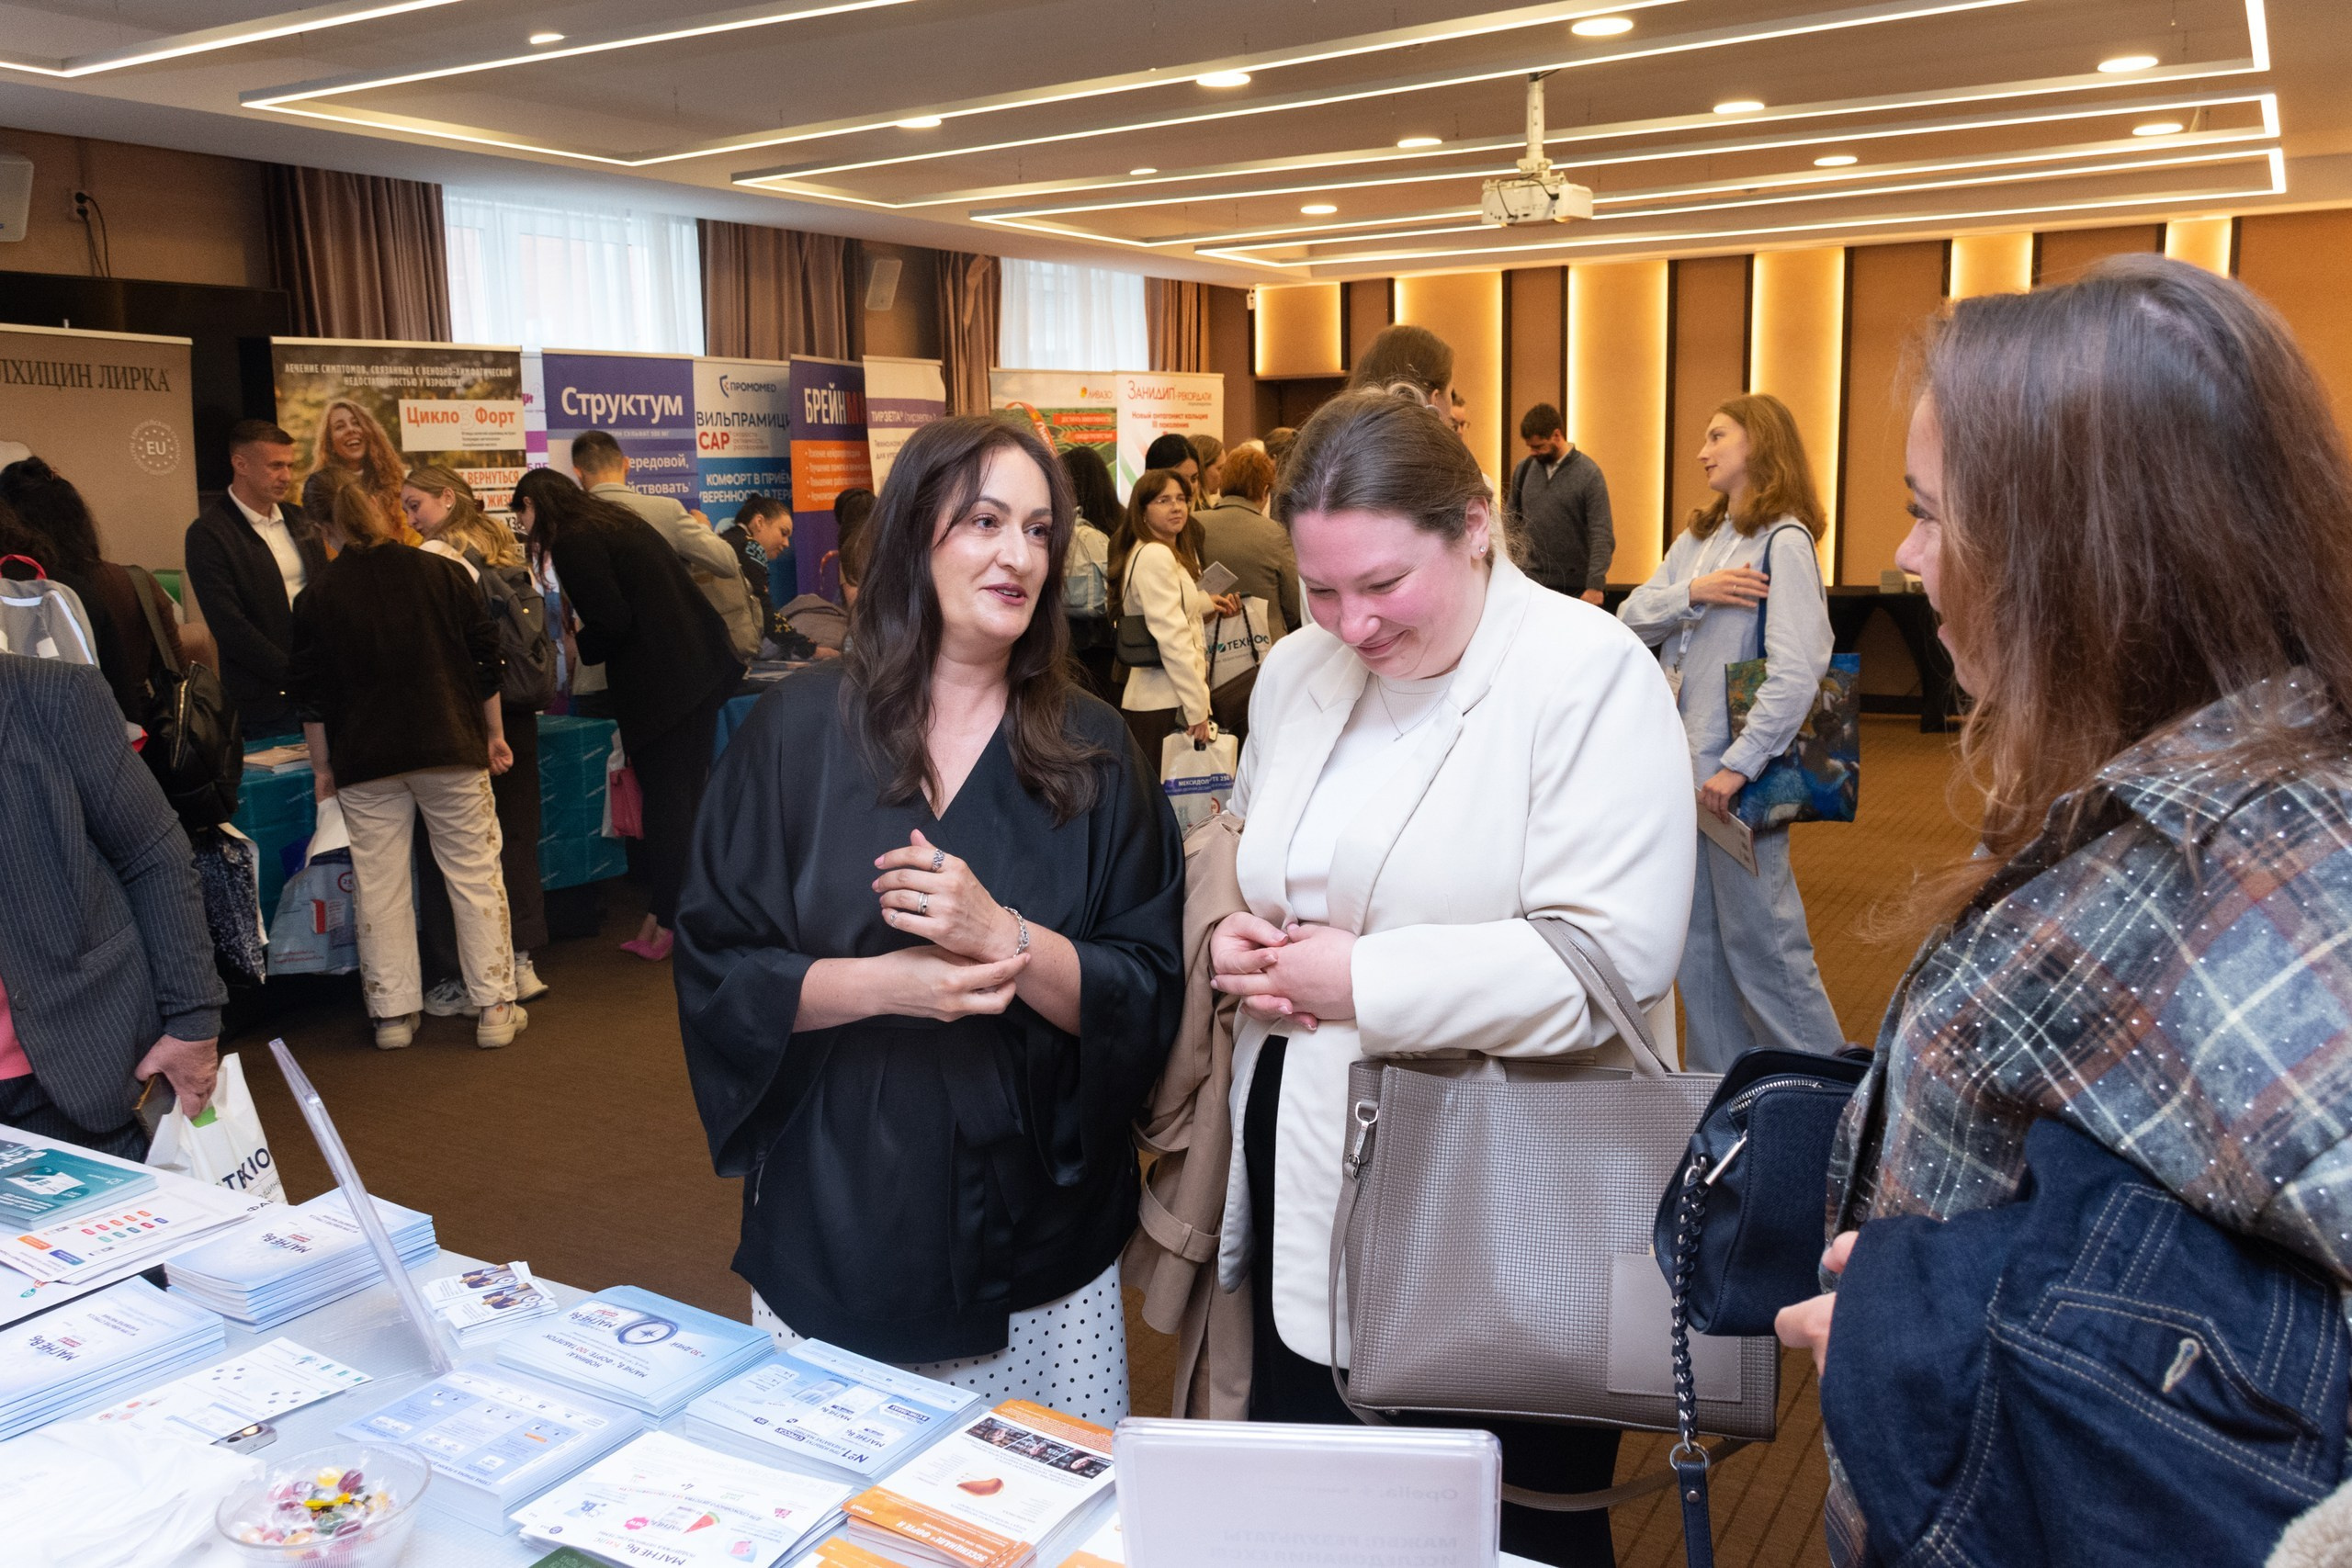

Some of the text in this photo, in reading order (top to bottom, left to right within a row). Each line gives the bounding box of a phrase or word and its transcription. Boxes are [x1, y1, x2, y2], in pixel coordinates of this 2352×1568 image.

[98, 365, 171, 392] ЛИРКА
[561, 387, 683, 424] Структум
[406, 407, 459, 427] Цикло
[475, 407, 514, 428] Форт
[1132, 412, 1151, 420] Новый
[146, 441, 166, 456] EU
[698, 432, 730, 450] САР
[628, 453, 689, 472] ередовой,
[467, 470, 519, 485] ВЕРНУТЬСЯ
[706, 473, 752, 486] КОМФОРТ
[754, 473, 760, 484] В
[566, 1351, 603, 1369] НОВИНКА!
[841, 1450, 869, 1464] №1
[903, 1523, 931, 1539] ФОРТЕ
[642, 1549, 686, 1566] МАГНЕ
